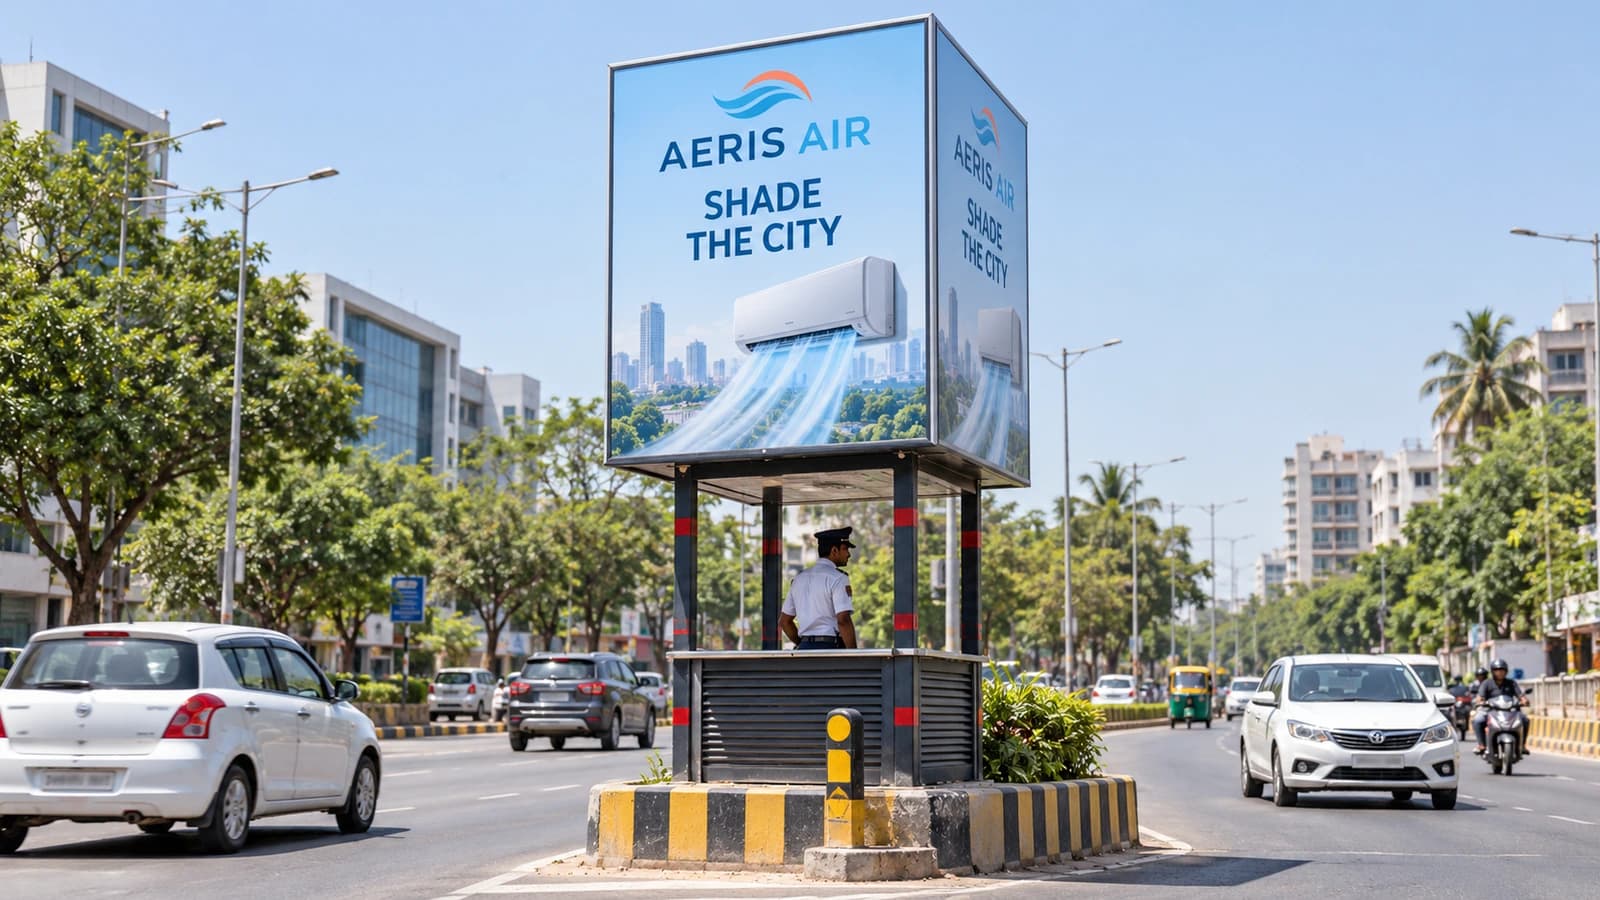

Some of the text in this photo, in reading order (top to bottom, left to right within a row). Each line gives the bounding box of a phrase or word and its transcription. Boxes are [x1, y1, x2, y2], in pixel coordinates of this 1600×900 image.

[659, 116, 871, 172] AERIS AIR
[704, 178, 821, 220] SHADE
[954, 134, 1014, 211] AERIS AIR
[686, 215, 842, 261] THE CITY
[968, 198, 1002, 250] SHADE
[962, 230, 1008, 288] THE CITY
